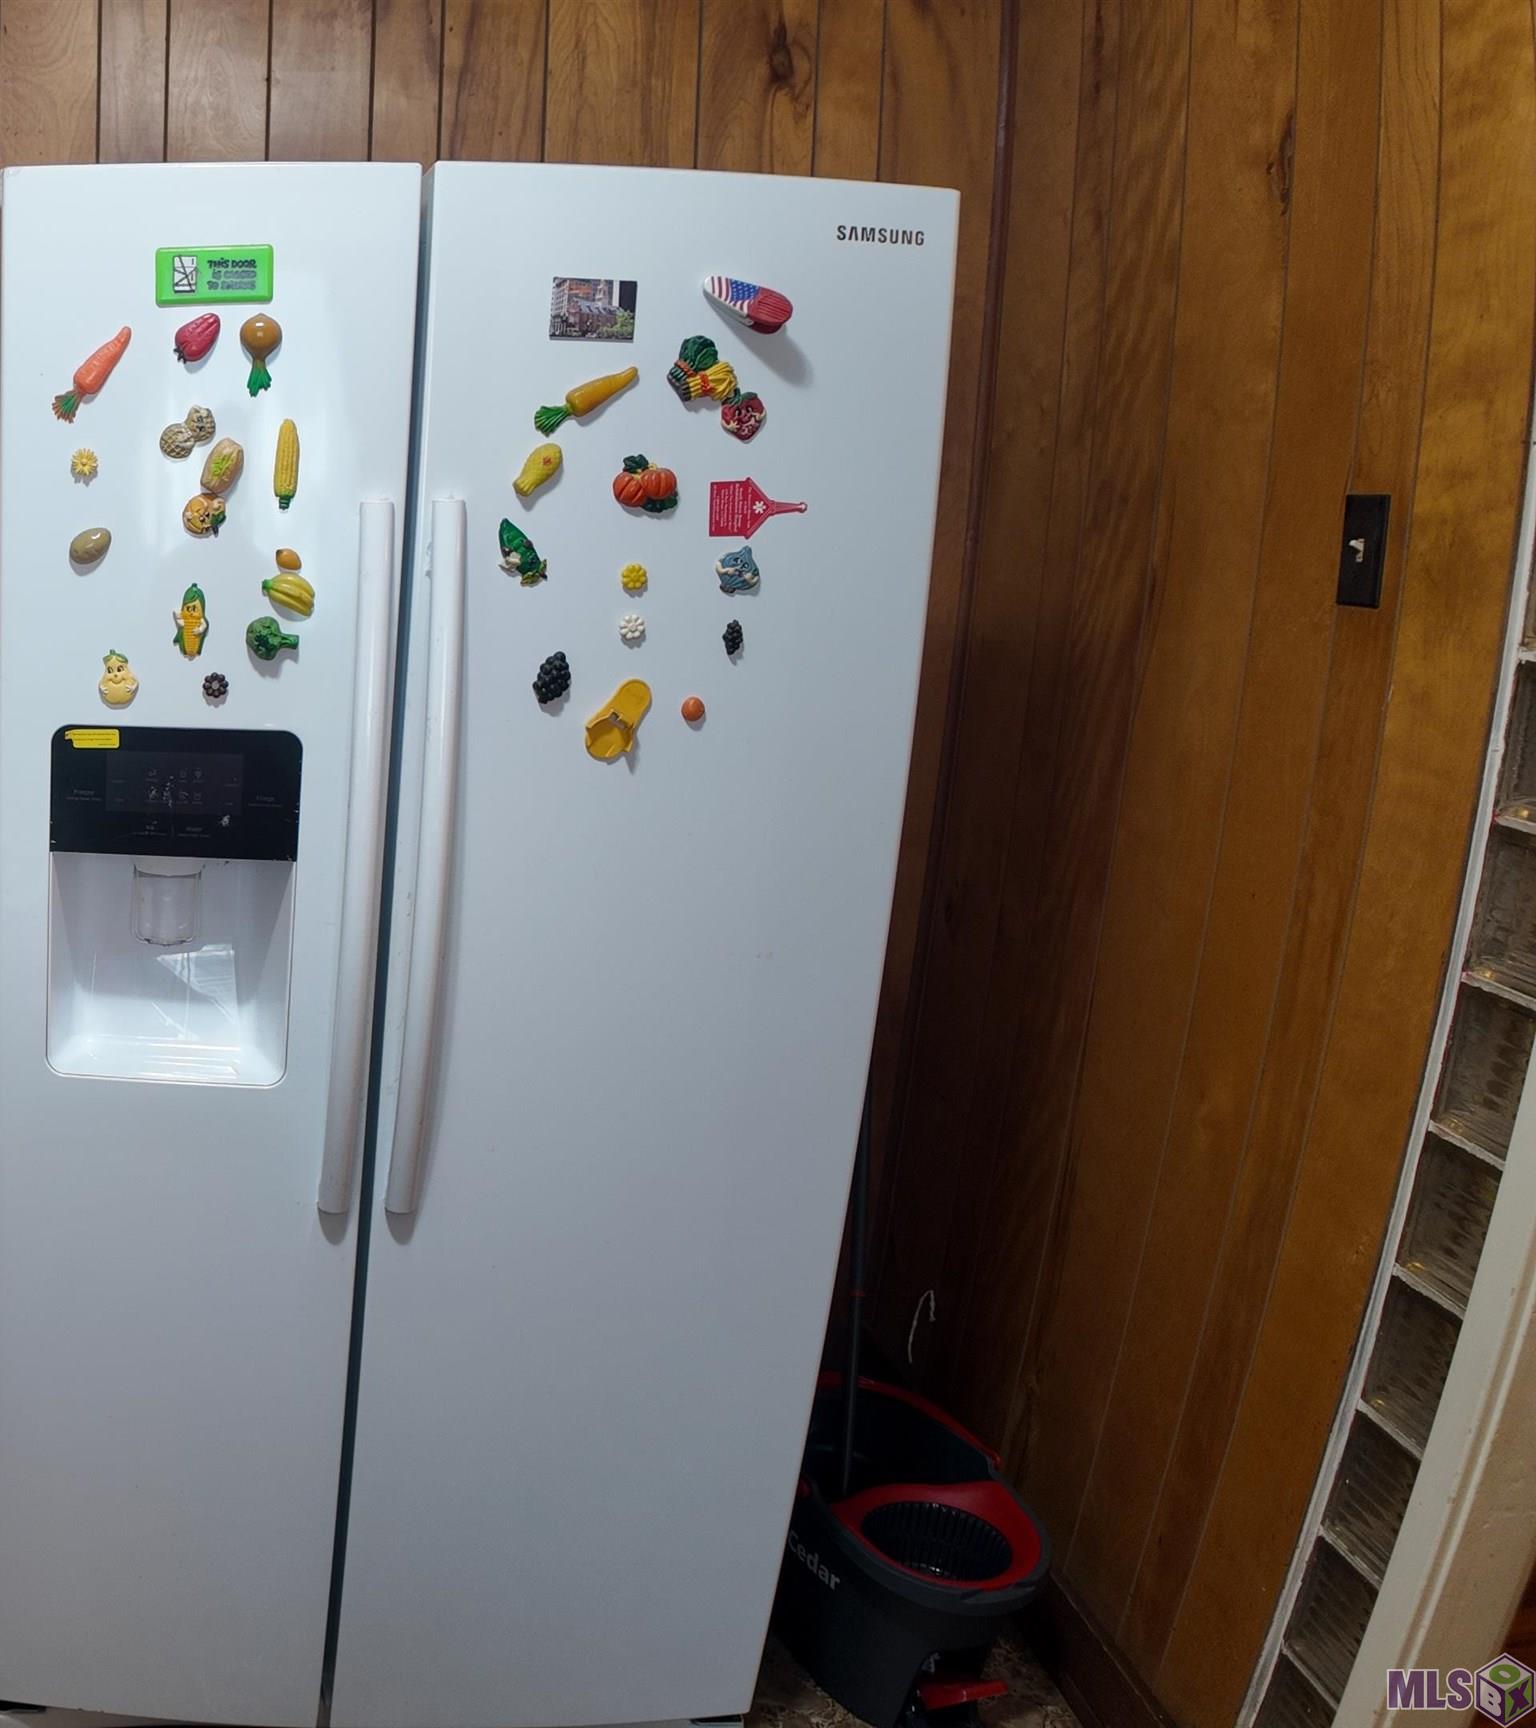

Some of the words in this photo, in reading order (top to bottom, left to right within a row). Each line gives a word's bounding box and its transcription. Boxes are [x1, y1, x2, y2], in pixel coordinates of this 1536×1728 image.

[836, 224, 925, 246] SAMSUNG
[231, 259, 257, 269] DOOR
[788, 1529, 841, 1590] Cedar
